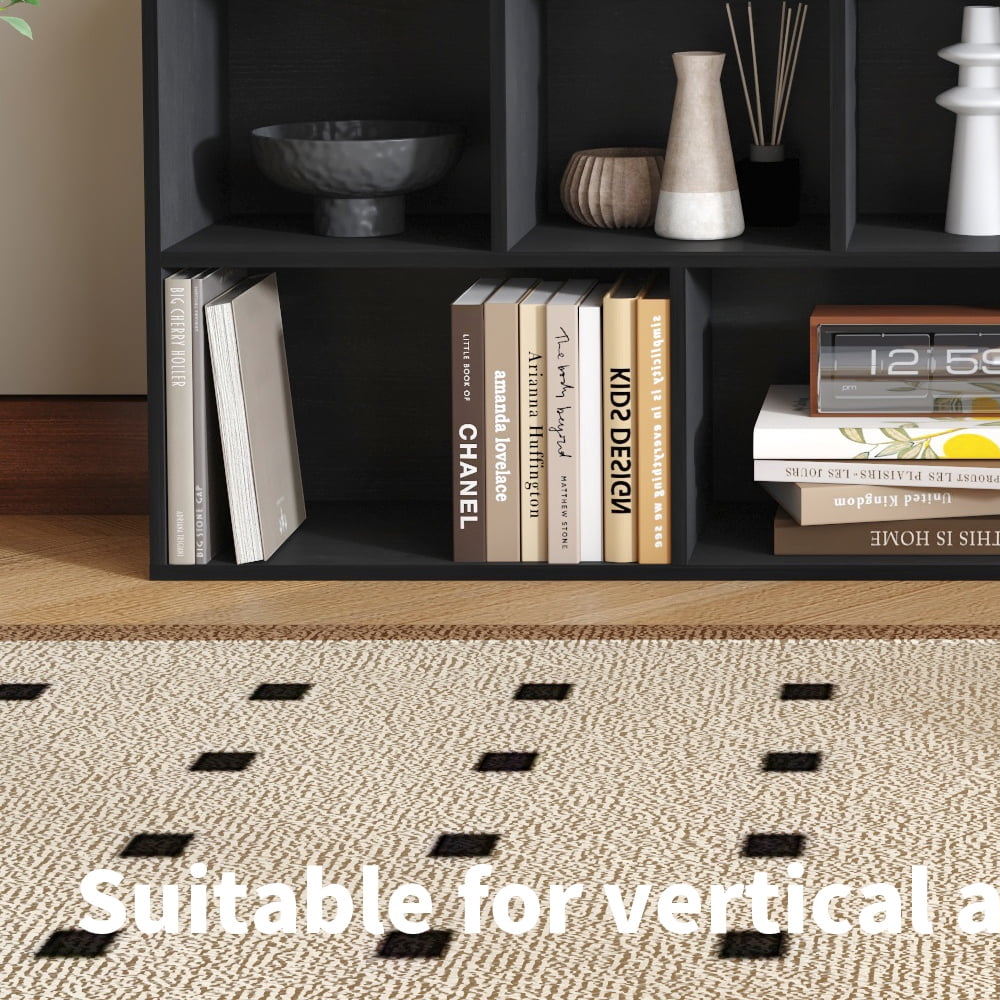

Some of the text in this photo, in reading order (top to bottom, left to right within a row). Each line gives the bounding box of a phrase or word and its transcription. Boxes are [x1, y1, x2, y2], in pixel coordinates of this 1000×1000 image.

[170, 287, 186, 387] BIG CHERRY HOLLER
[554, 327, 570, 359] The
[870, 349, 919, 376] 12
[464, 390, 470, 401] OF
[494, 370, 510, 502] amanda lovelace
[525, 351, 544, 518] Arianna Huffington
[459, 423, 478, 530] CHANEL
[786, 467, 823, 479] JOURS
[828, 469, 851, 479] LES
[860, 470, 922, 481] PLAISIRS
[928, 472, 953, 482] LES
[956, 474, 1000, 483] PROUST
[834, 492, 952, 508] United Kingdom
[870, 530, 929, 547] HOME
[937, 530, 953, 547] IS
[196, 540, 204, 558] BIG
